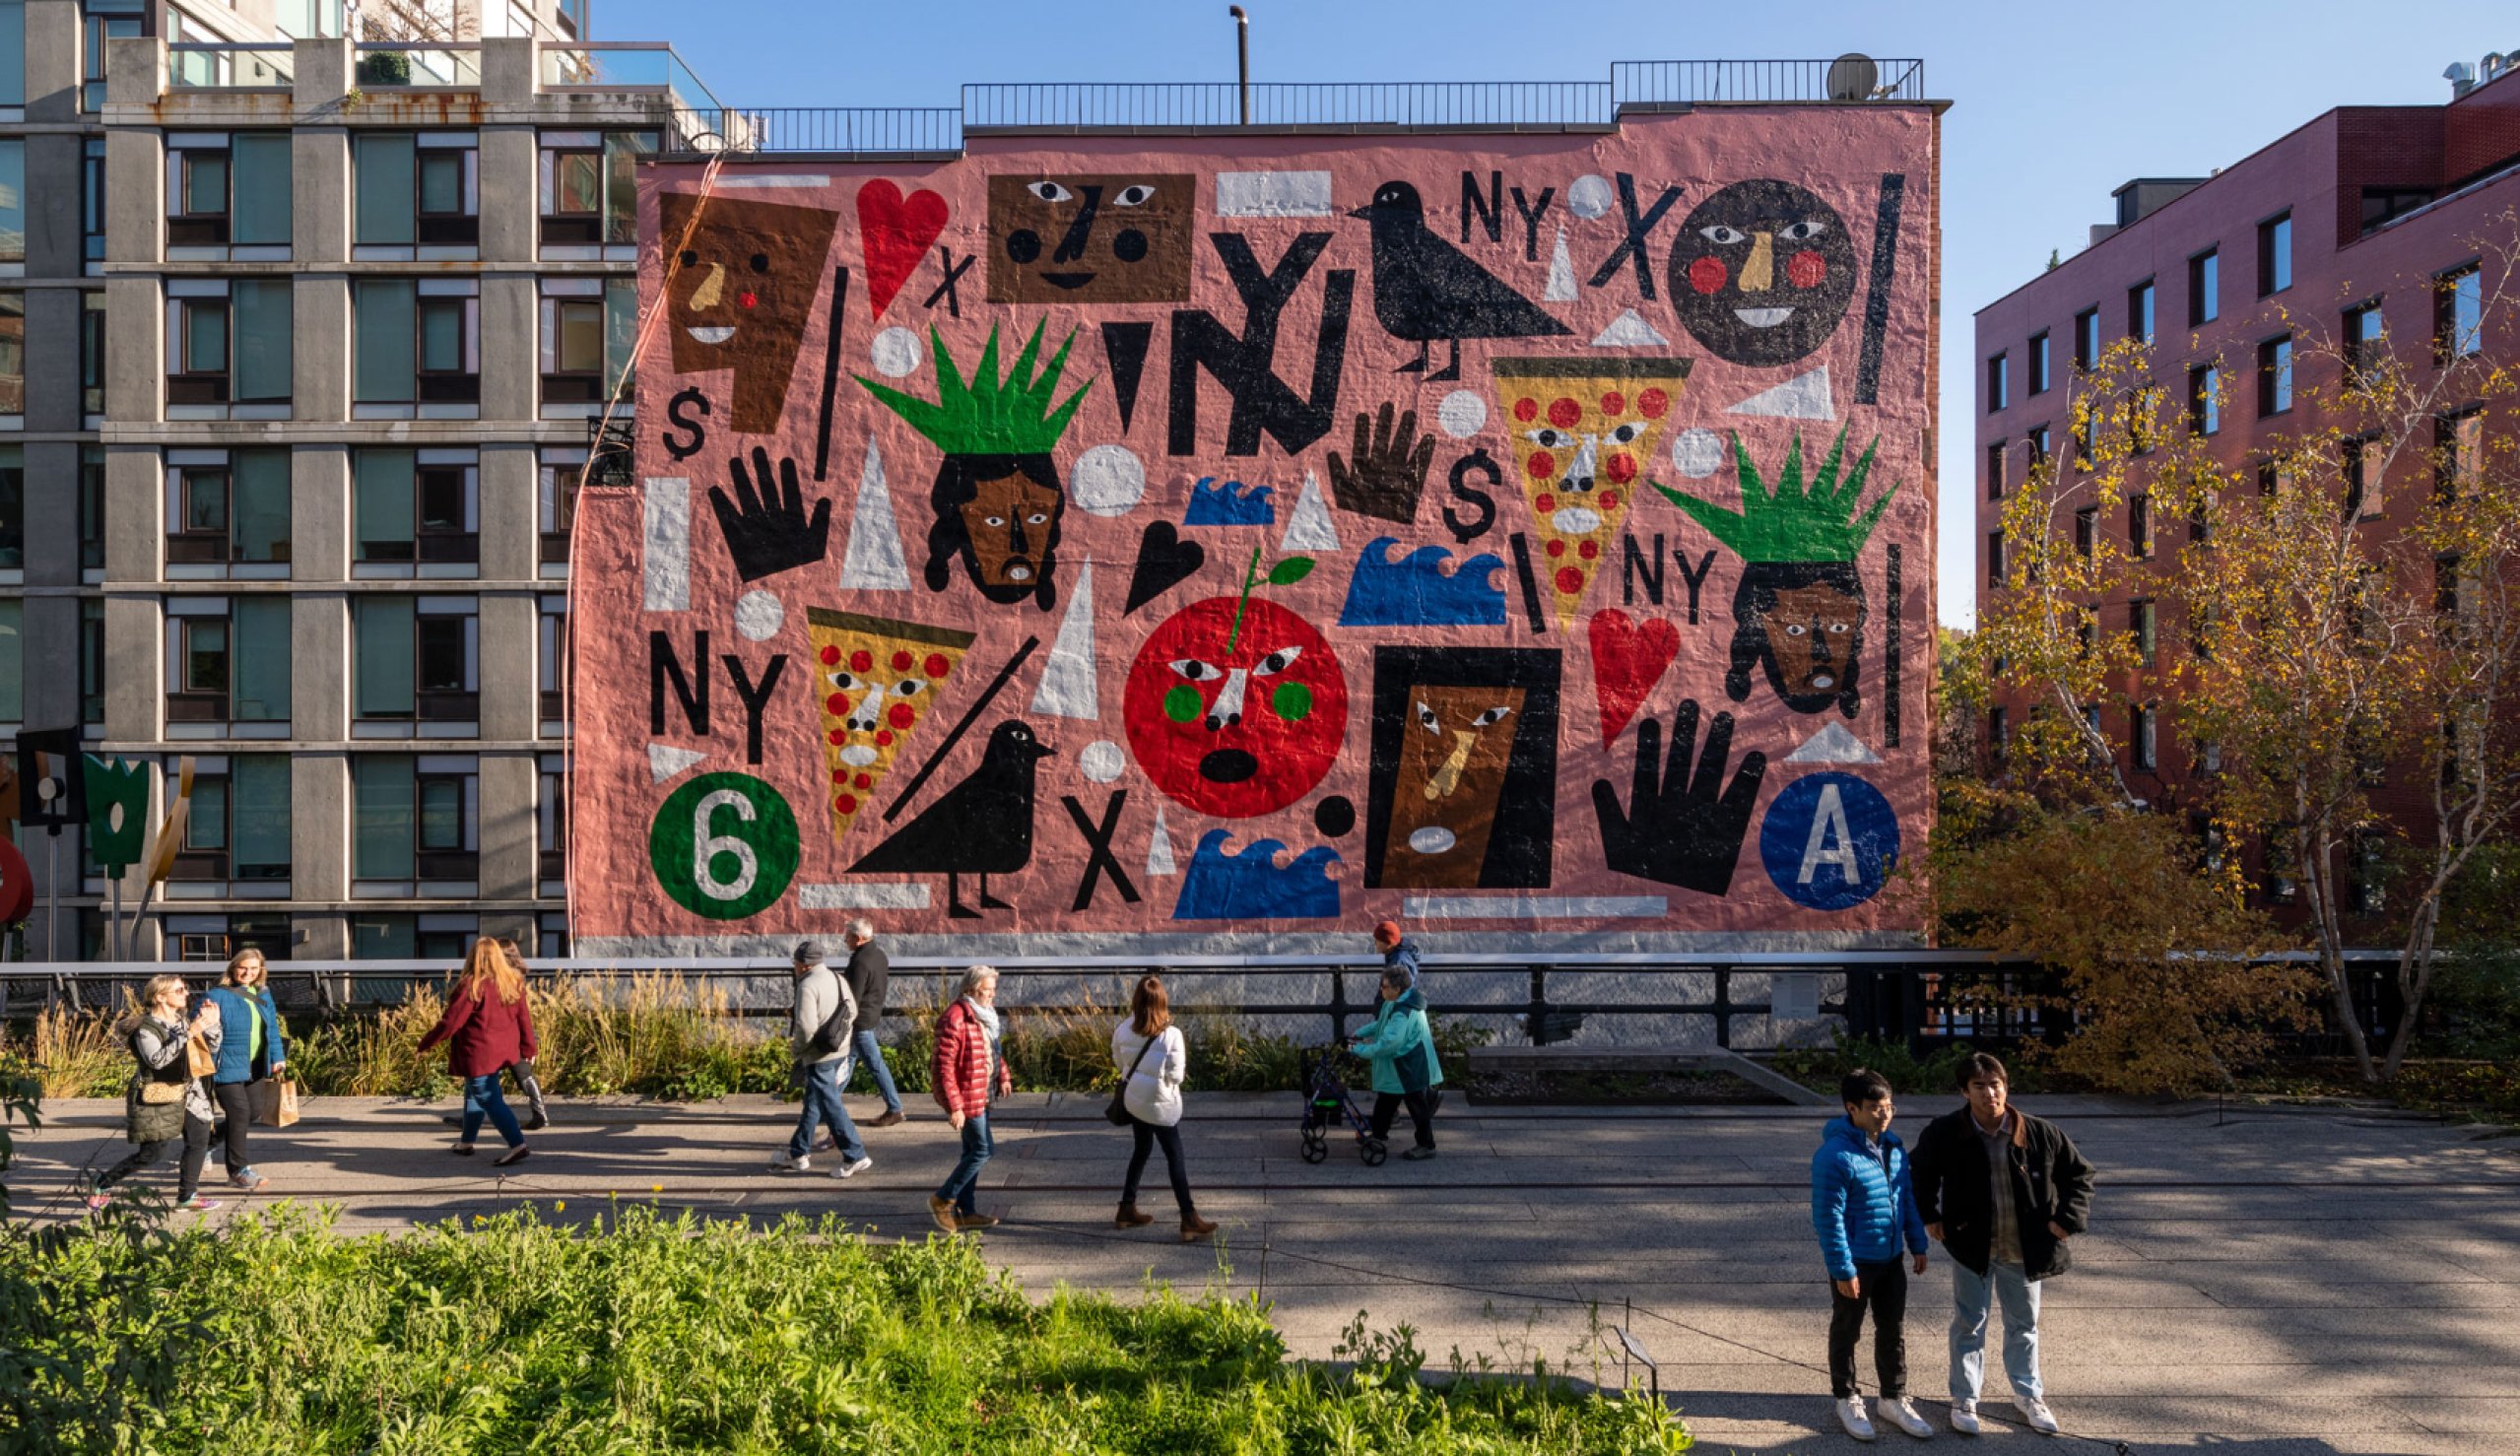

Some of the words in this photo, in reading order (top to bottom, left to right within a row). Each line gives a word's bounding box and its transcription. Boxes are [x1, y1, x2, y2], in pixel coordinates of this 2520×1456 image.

[1460, 169, 1556, 262] NY
[1167, 232, 1357, 457] NY
[1622, 533, 1717, 626] NY
[648, 629, 788, 765] NY
[693, 788, 759, 901] 6
[1796, 783, 1861, 885] A
